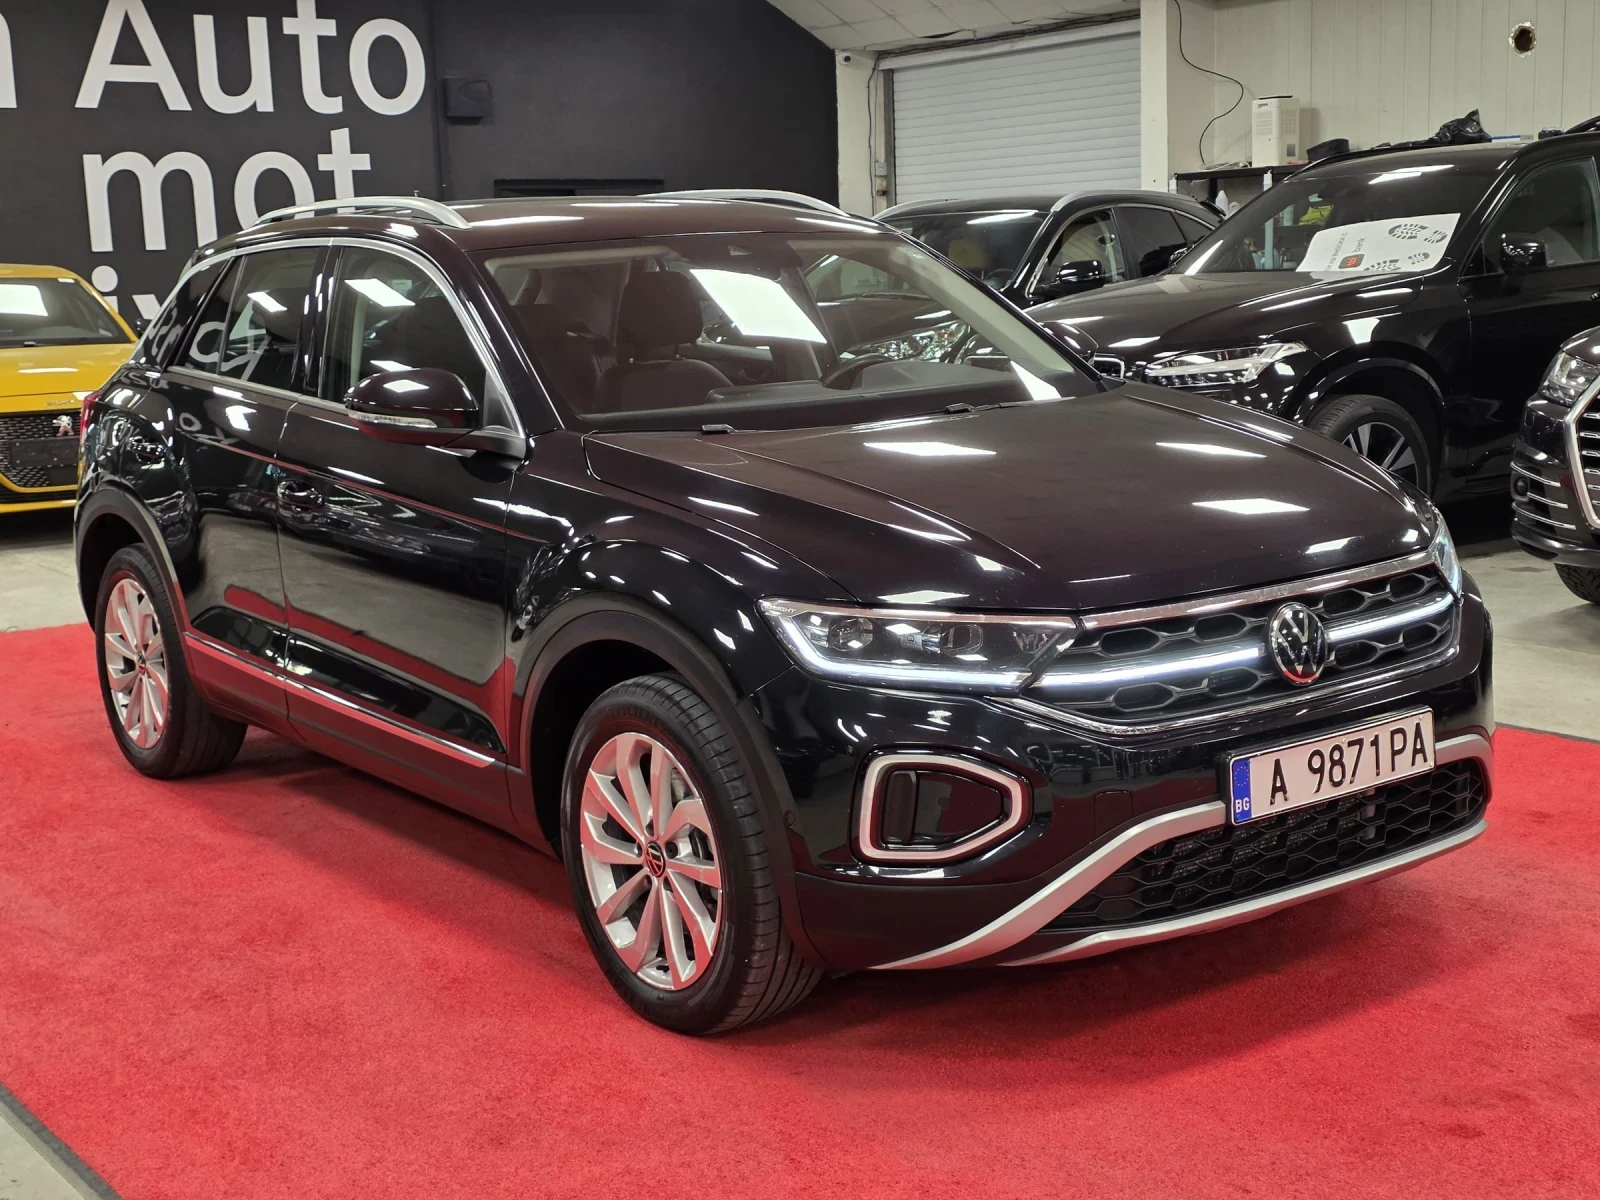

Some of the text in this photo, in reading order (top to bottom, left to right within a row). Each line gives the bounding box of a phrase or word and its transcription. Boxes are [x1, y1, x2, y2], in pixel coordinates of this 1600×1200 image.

[74, 0, 426, 116] Auto
[1235, 797, 1251, 813] BG
[1269, 757, 1290, 806] A
